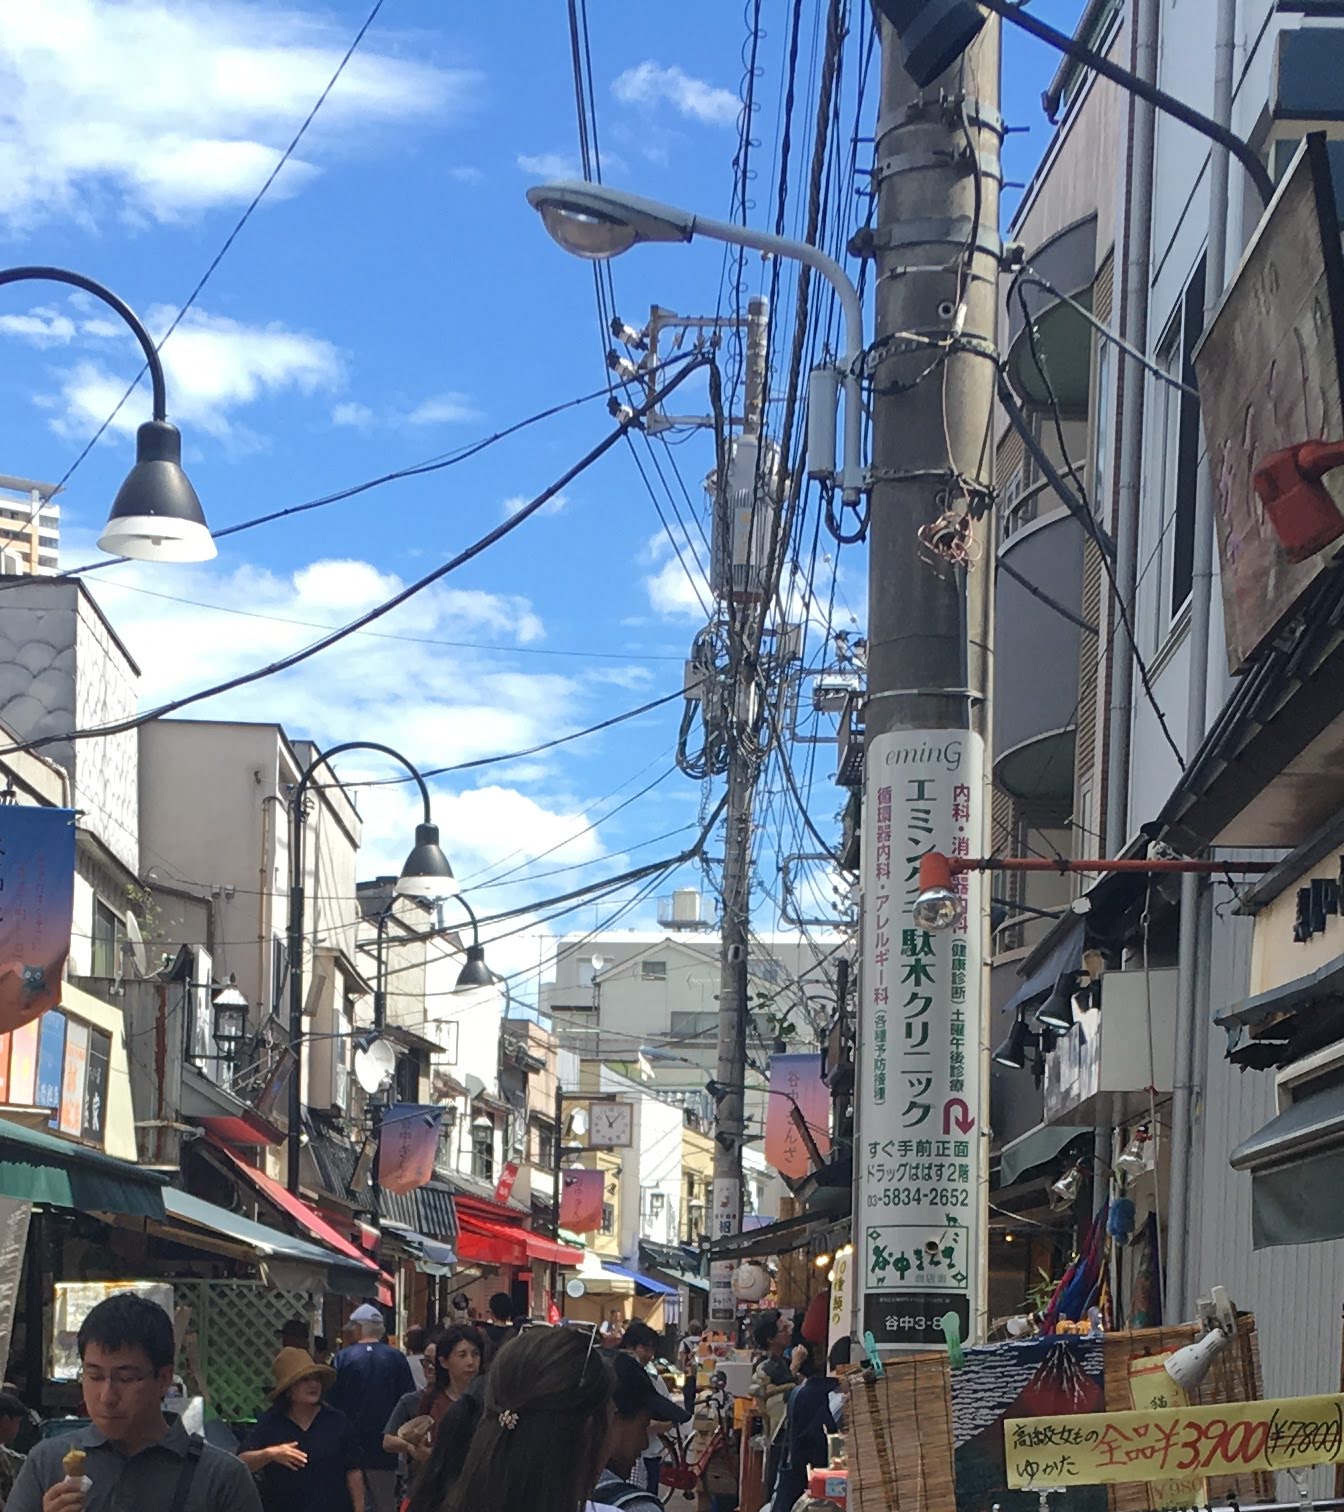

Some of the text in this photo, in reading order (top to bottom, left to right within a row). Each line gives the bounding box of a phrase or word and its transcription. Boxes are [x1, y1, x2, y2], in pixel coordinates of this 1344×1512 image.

[885, 741, 963, 771] eminG
[901, 779, 937, 1128] エミン駄木クリニック
[868, 1139, 969, 1159] すぐ手前正面
[867, 1187, 969, 1207] 03-5834-2652
[1015, 1454, 1080, 1485] ゆかた
